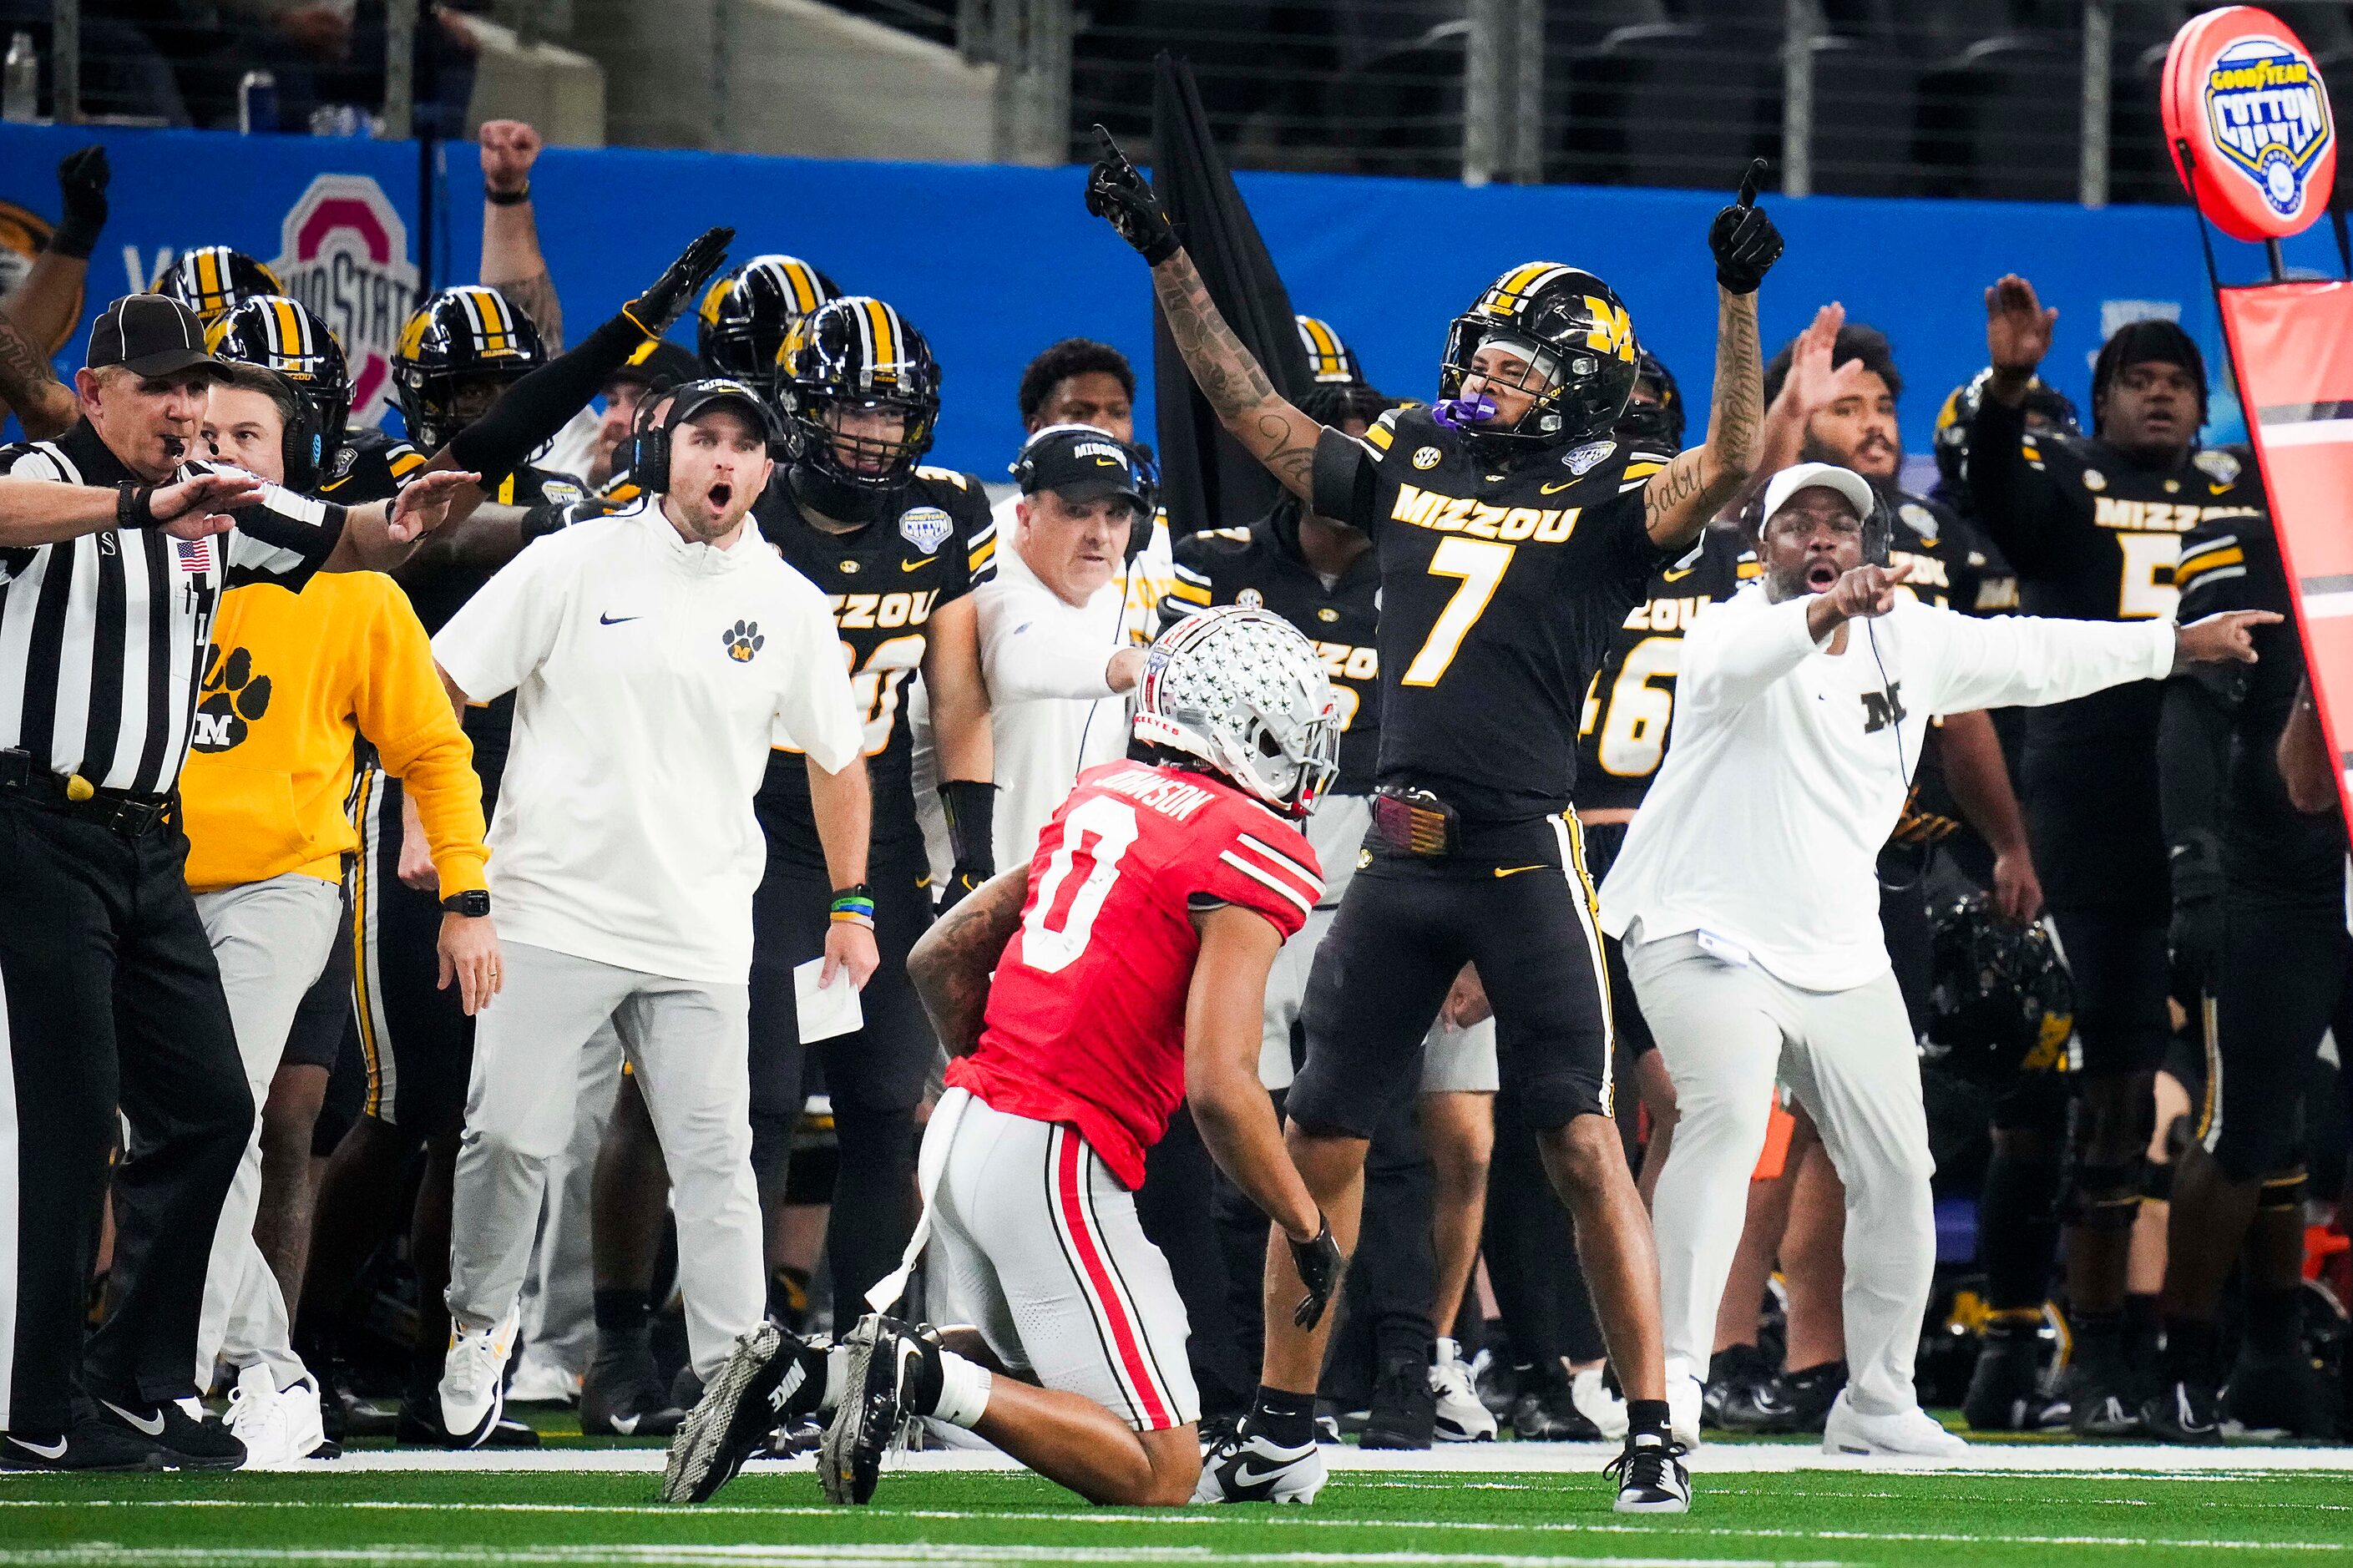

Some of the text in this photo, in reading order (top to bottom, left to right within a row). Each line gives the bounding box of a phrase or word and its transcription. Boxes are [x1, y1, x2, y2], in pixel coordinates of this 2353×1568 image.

[2211, 59, 2308, 90] GOODYEAR
[2213, 87, 2321, 148] COTTON
[2237, 121, 2306, 159] BOWL
[334, 252, 418, 356] STAT
[1583, 295, 1635, 365] M
[1415, 448, 1440, 468] SEC
[1390, 482, 1582, 544] MIZZOU
[1401, 536, 1517, 687] 7
[732, 644, 751, 661] M
[1308, 639, 1379, 680] ZO
[194, 713, 233, 746] M
[1860, 680, 1906, 735] M
[1091, 769, 1216, 822] JOHNSON
[1021, 795, 1138, 974] 0
[767, 1357, 807, 1413] NIKE
